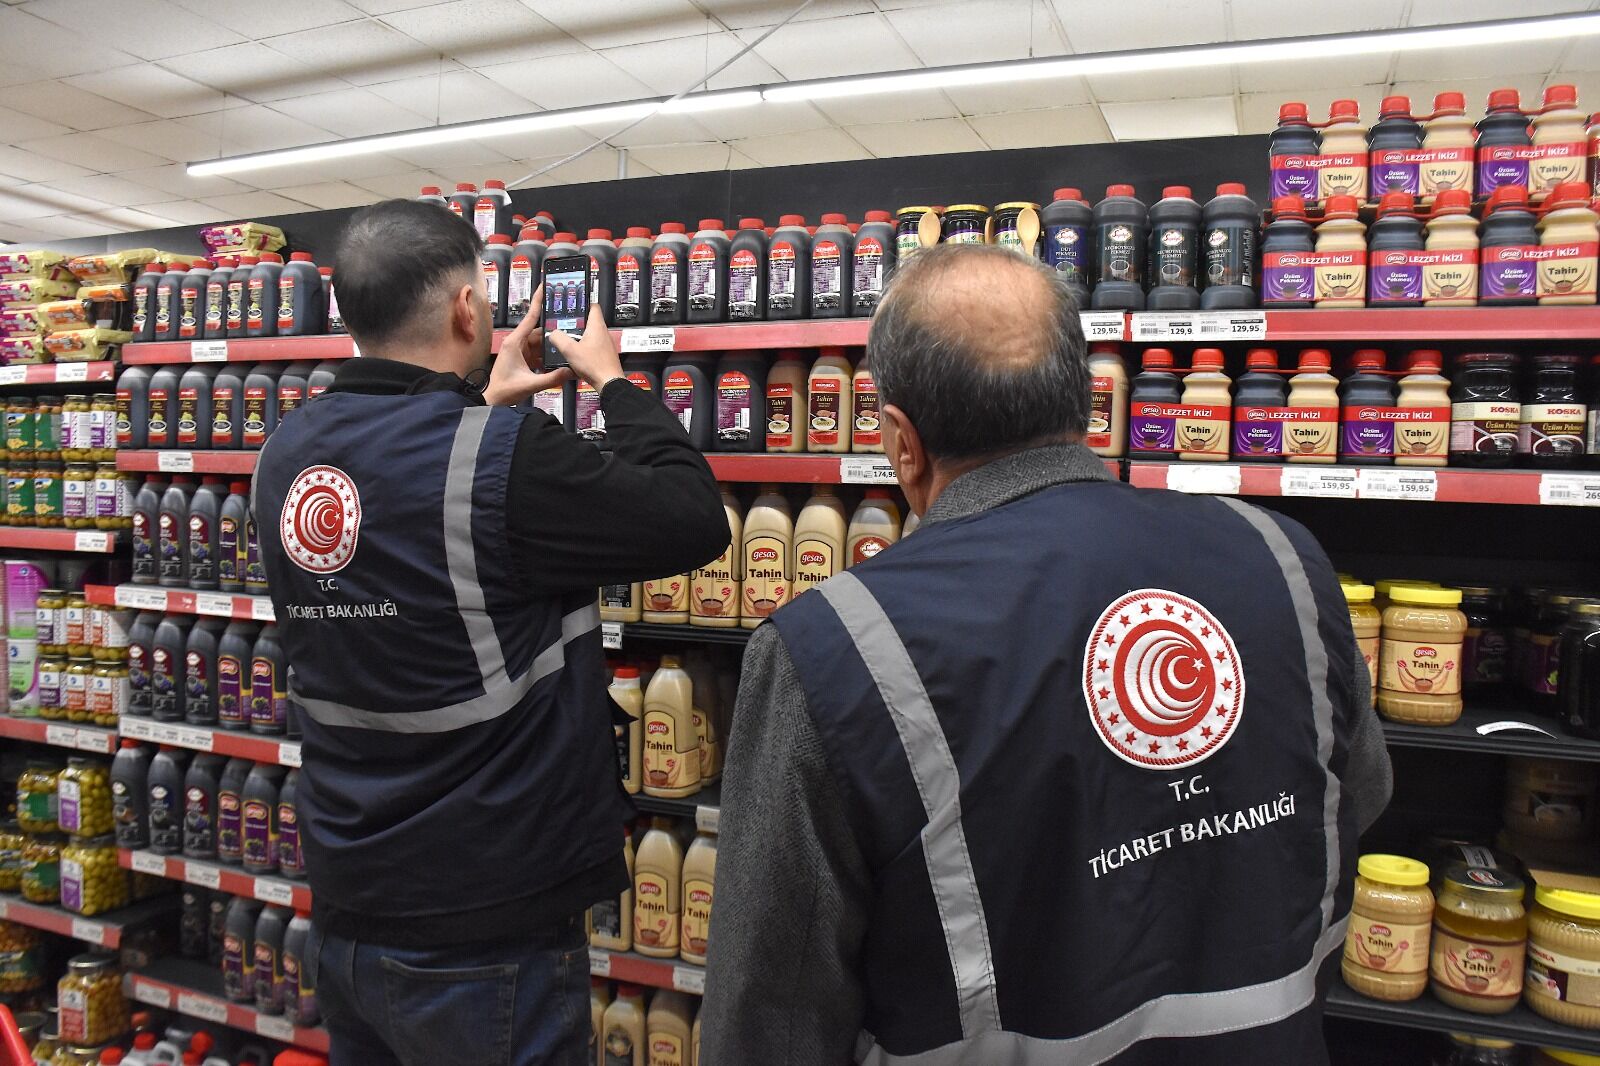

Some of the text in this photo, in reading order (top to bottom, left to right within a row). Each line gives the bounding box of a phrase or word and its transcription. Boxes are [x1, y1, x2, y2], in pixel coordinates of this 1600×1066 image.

[1405, 153, 1435, 161] LEZZET
[1516, 149, 1545, 158] LEZZET
[1305, 159, 1332, 167] LEZZET
[1429, 169, 1457, 177] Tahin
[1539, 165, 1568, 174] Tahin
[1327, 173, 1353, 181] Tahin
[1524, 250, 1553, 258] LEZZET
[1409, 255, 1440, 263] LEZZET
[1548, 266, 1578, 275] Tahin
[1326, 273, 1352, 281] Tahin
[1433, 272, 1462, 280] Tahin
[1092, 327, 1118, 335] 129,95
[1170, 327, 1193, 335] 129,9
[1232, 325, 1260, 333] 129,95
[1490, 406, 1520, 414] KOSKA
[1185, 425, 1211, 434] Tahin
[1293, 428, 1320, 437] Tahin
[1405, 429, 1432, 437] Tahin
[1322, 481, 1350, 490] 159,95
[1400, 484, 1429, 493] 159,95
[699, 568, 729, 579] Tahin
[749, 568, 782, 578] Tahin
[317, 579, 339, 591] T.C.
[286, 599, 398, 619] TİCARET BAKANLIĞI
[1412, 660, 1439, 669] Tahin
[646, 740, 673, 750] Tahin
[1168, 775, 1210, 802] T.C.
[1088, 791, 1296, 879] TİCARET BAKANLIĞI
[638, 900, 665, 911] Tahin
[688, 907, 709, 919] Tahi
[1368, 936, 1393, 948] Tahin
[1462, 960, 1496, 974] Tahin
